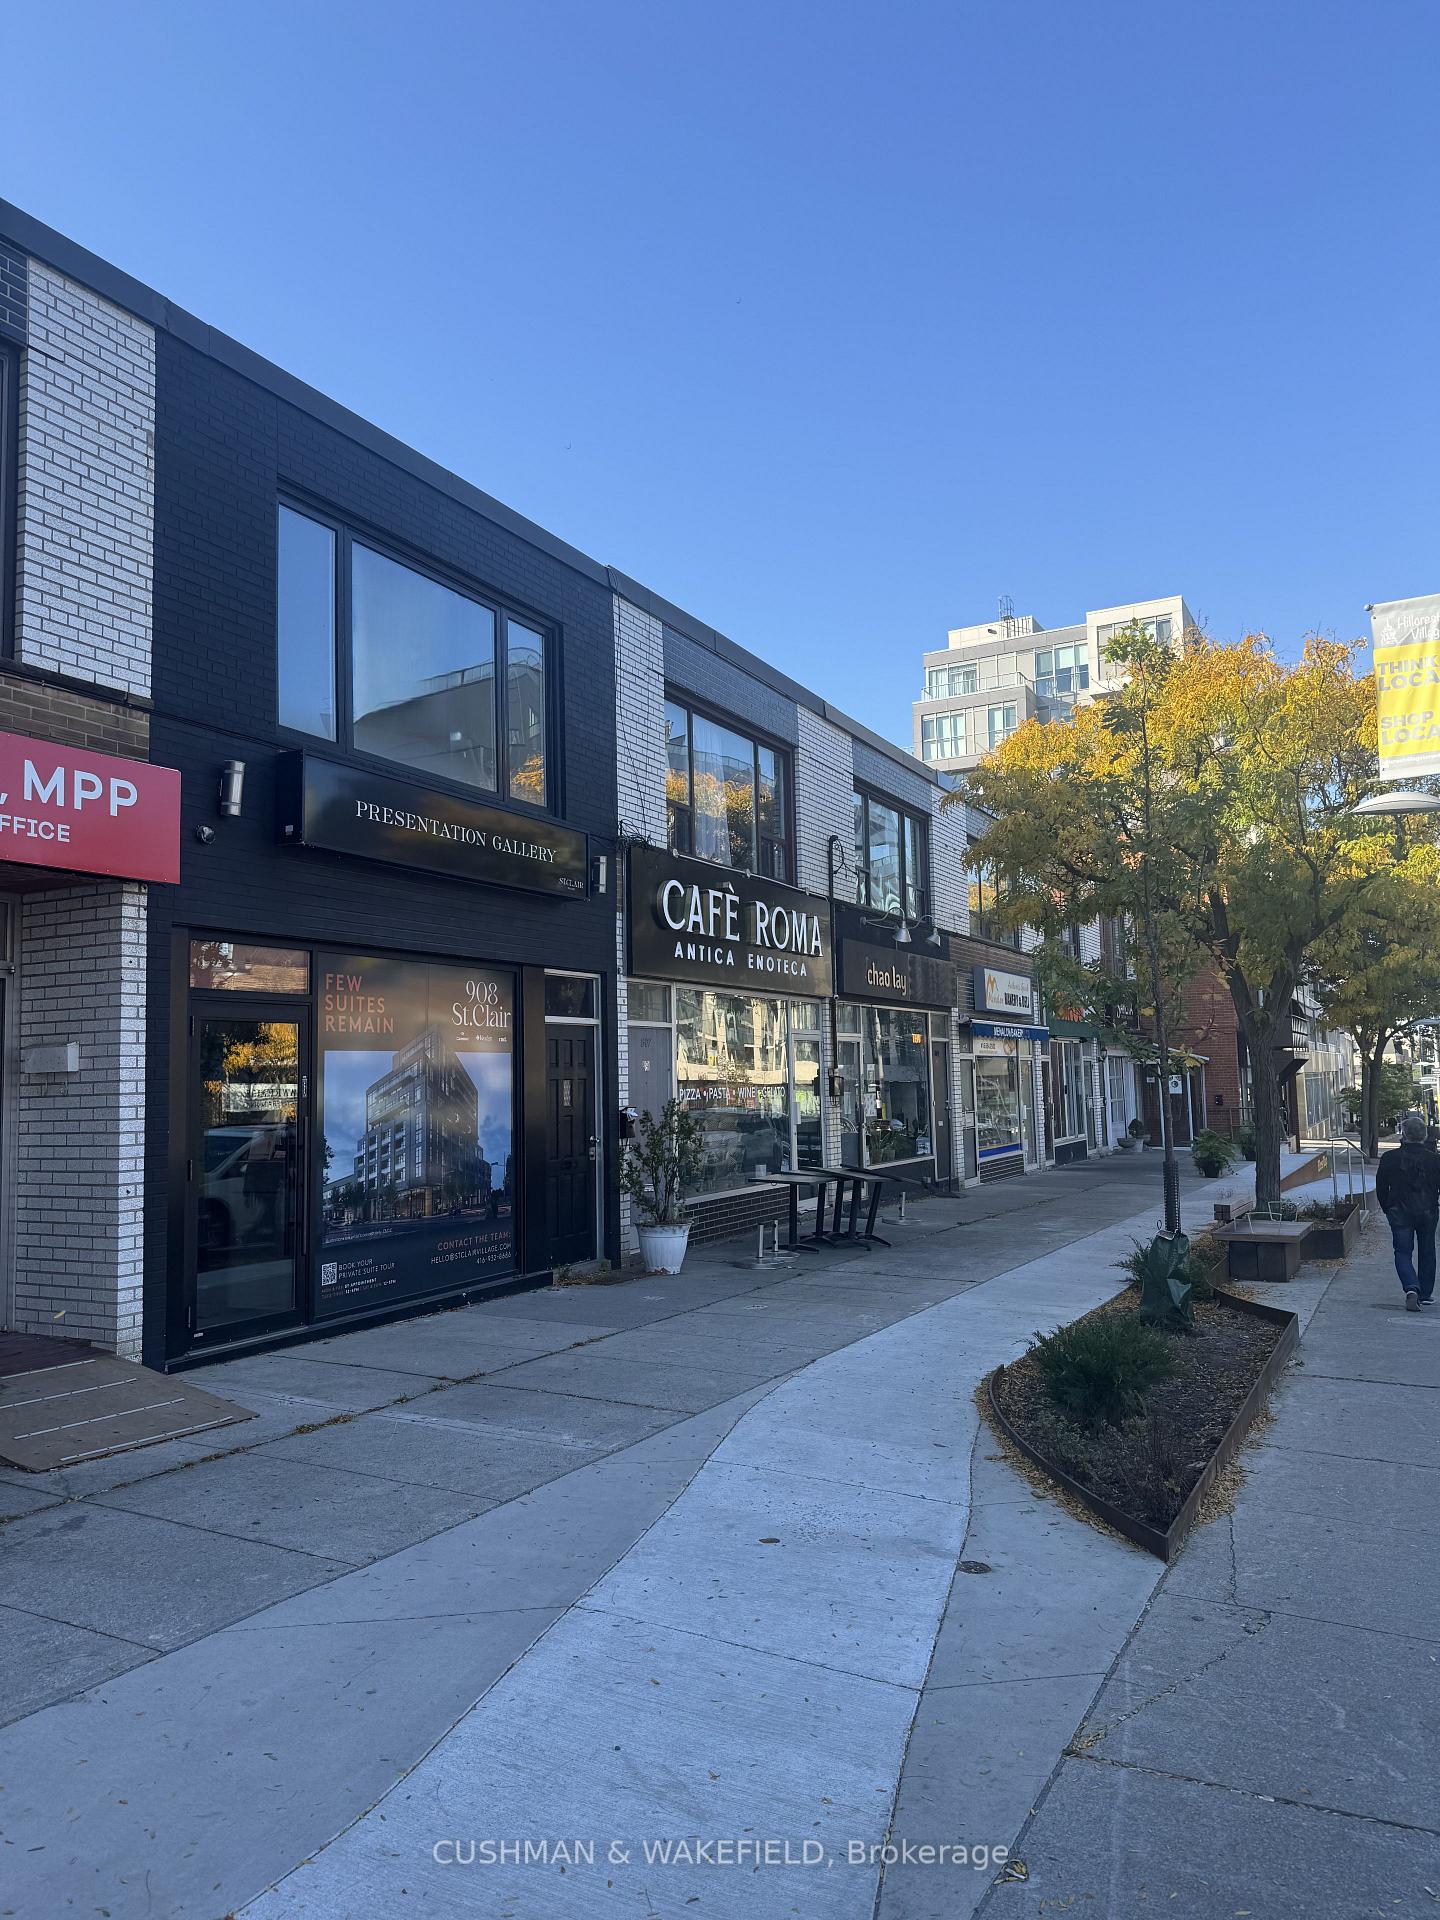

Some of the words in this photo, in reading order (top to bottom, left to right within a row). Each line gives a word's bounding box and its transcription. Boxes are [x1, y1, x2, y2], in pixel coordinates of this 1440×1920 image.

[1377, 655, 1439, 676] THINK
[1381, 711, 1434, 730] SHOP
[24, 759, 138, 817] MPP
[355, 800, 487, 847] PRESENTATION
[492, 835, 557, 863] GALLERY
[755, 900, 824, 957] ROMA
[674, 941, 735, 966] ANTICA
[748, 953, 807, 977] ENOTECA
[325, 973, 362, 993] FEW
[867, 961, 890, 988] chao
[892, 965, 906, 997] lay
[466, 980, 499, 1005] 908
[325, 994, 385, 1014] SUITES
[325, 1015, 395, 1034] REMAIN
[679, 1088, 701, 1101] PIZZA
[708, 1087, 730, 1099] PASTA
[737, 1086, 756, 1098] WINE
[762, 1086, 785, 1098] GELATO
[437, 1237, 472, 1251] CONTACT
[475, 1234, 488, 1244] THE
[491, 1231, 511, 1241] TEAM:
[338, 1262, 355, 1271] BOOK
[357, 1258, 373, 1267] YOUR
[338, 1268, 361, 1279] PRIVATE
[363, 1265, 378, 1275] SUITE
[380, 1261, 396, 1271] TOUR
